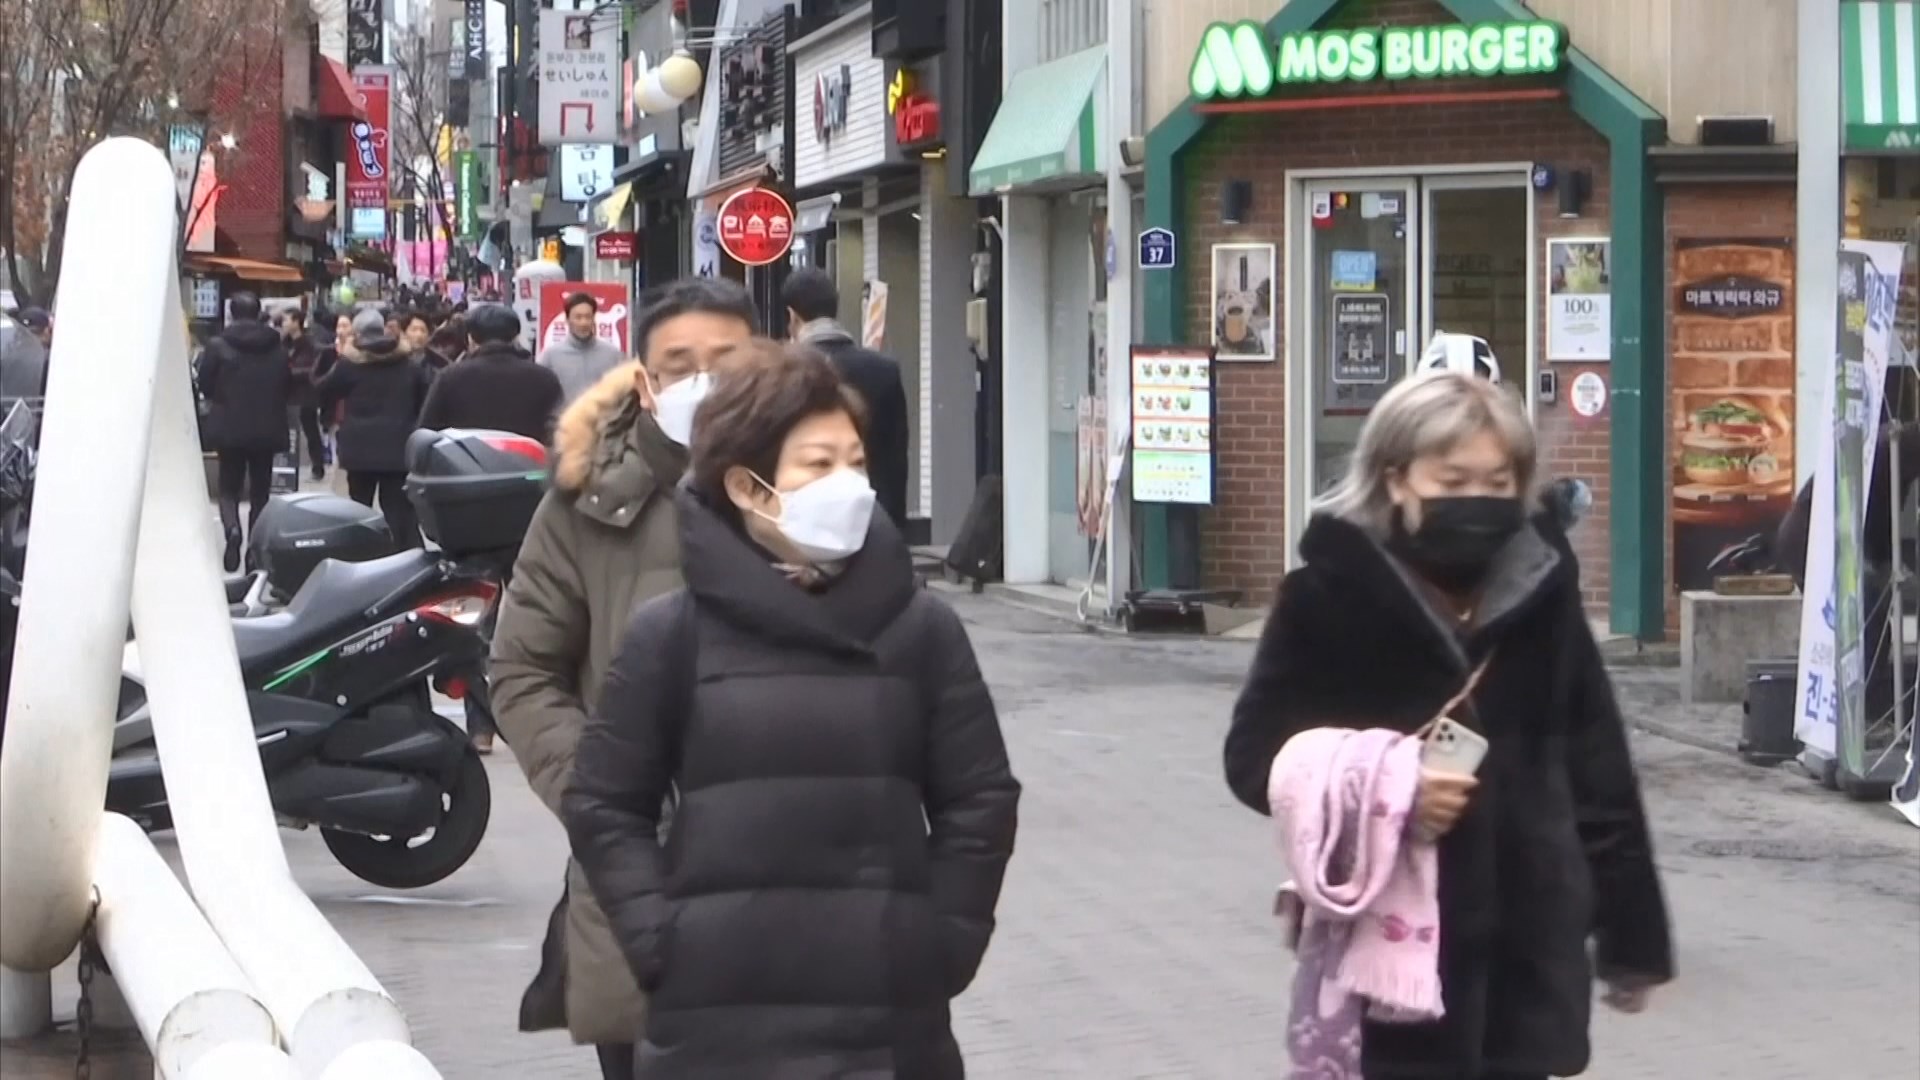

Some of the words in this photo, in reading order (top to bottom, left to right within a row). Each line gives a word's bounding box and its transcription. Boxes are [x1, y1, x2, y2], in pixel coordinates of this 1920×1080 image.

[468, 19, 482, 60] AHC
[1279, 31, 1378, 80] MOS
[1383, 24, 1558, 76] BURGER
[545, 67, 608, 82] せいしゅん
[1149, 247, 1164, 263] 37
